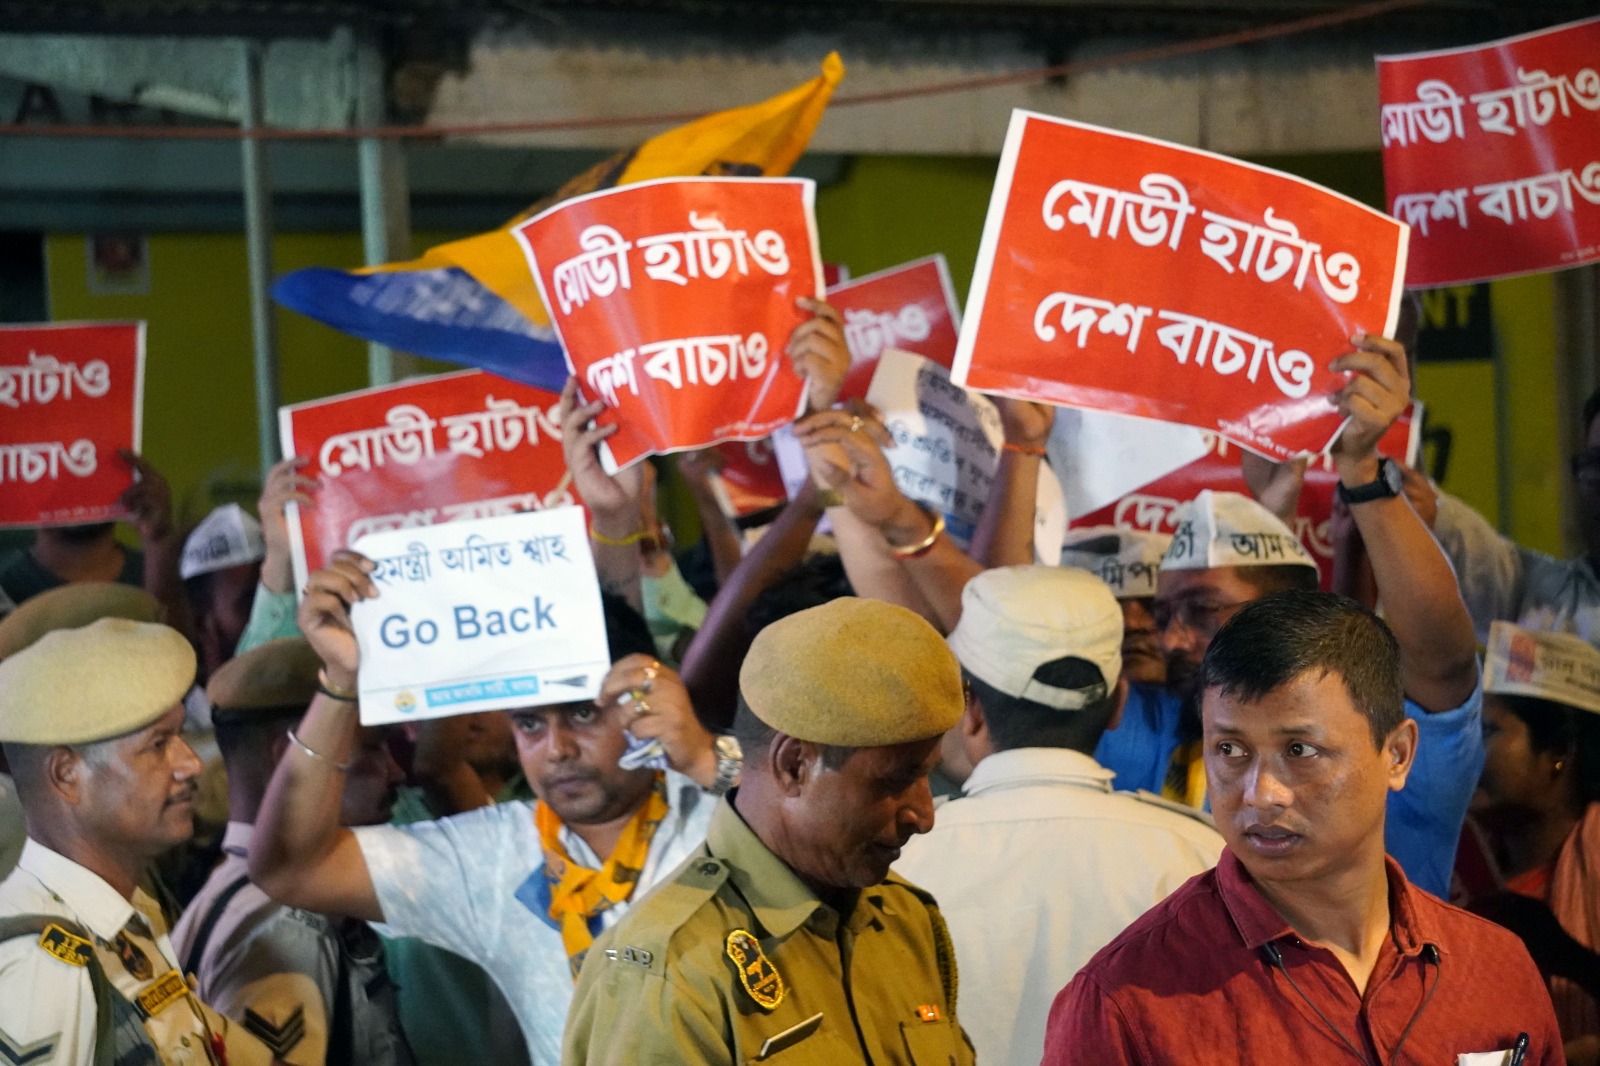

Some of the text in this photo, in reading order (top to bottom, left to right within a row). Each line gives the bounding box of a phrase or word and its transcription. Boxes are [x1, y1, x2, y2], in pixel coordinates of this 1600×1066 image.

[1393, 187, 1468, 237] দেশ
[636, 210, 790, 286] হাটাও
[1200, 207, 1361, 304] হাটাও
[639, 331, 769, 390] বাচাও
[1034, 292, 1314, 399] দেশ বাচাও
[440, 534, 512, 573] অমিত
[380, 596, 557, 649] Go Back
